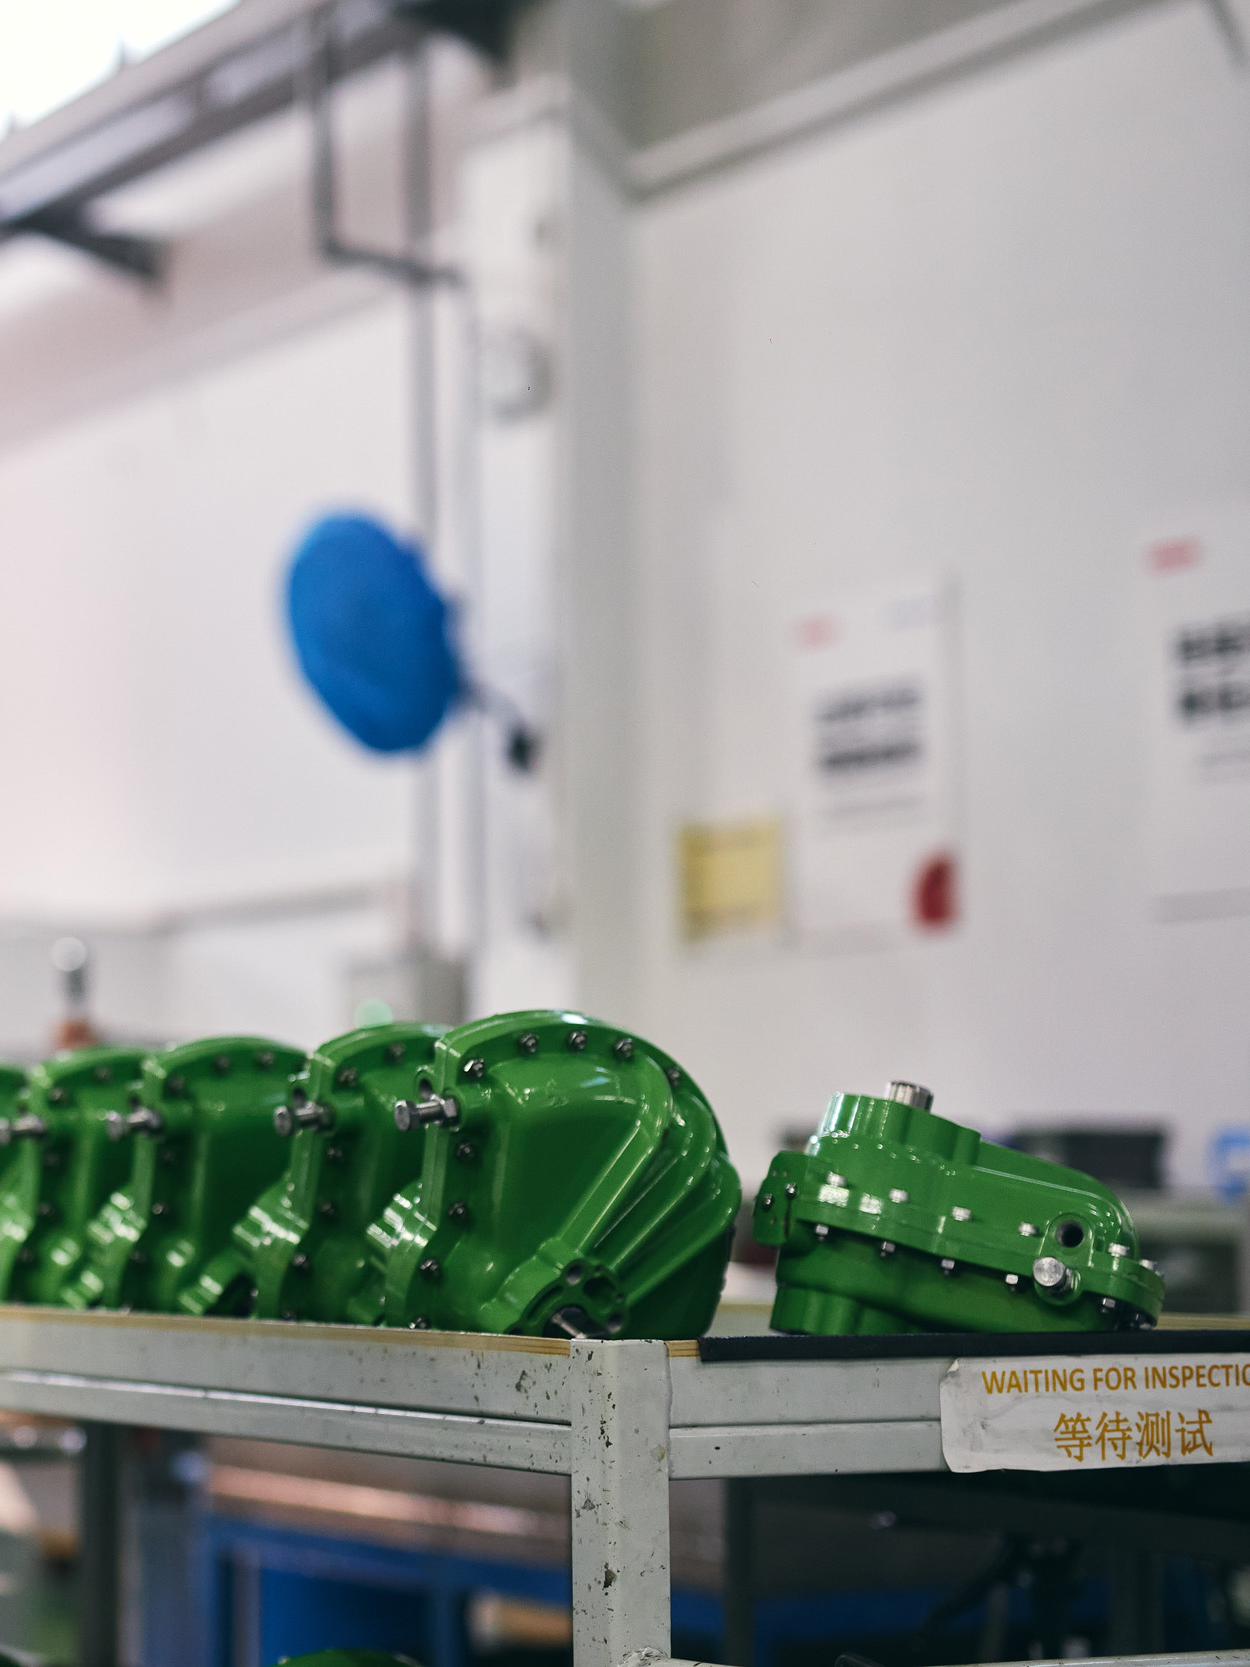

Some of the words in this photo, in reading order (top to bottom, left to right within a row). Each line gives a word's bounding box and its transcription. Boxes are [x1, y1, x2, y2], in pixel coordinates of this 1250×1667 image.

[982, 1368, 1085, 1394] WAITING
[1093, 1367, 1137, 1391] FOR
[1054, 1409, 1213, 1462] 等待测试
